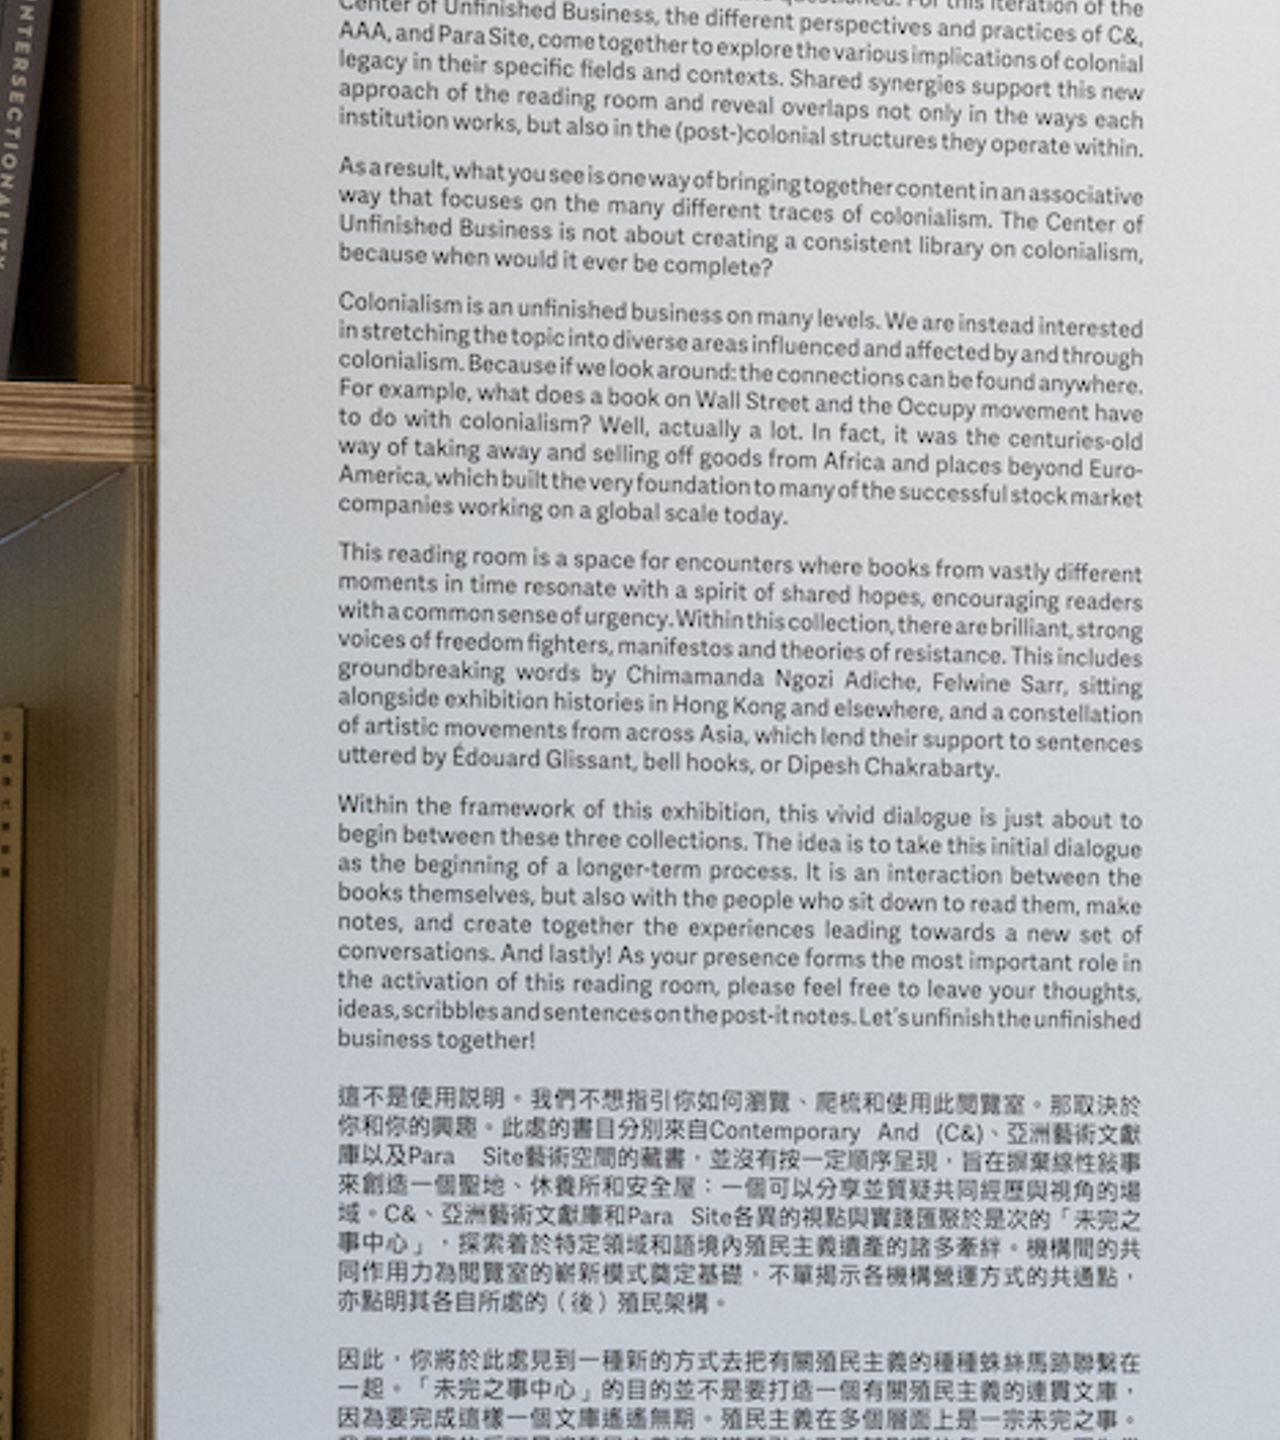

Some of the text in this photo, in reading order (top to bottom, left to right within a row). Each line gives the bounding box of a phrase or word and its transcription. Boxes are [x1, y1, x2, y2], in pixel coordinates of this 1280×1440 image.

[337, 743, 1001, 784] uttered by Édouard Glissant, bell hooks, or Dipesh Chakrabarty.
[337, 1026, 536, 1055] business together!
